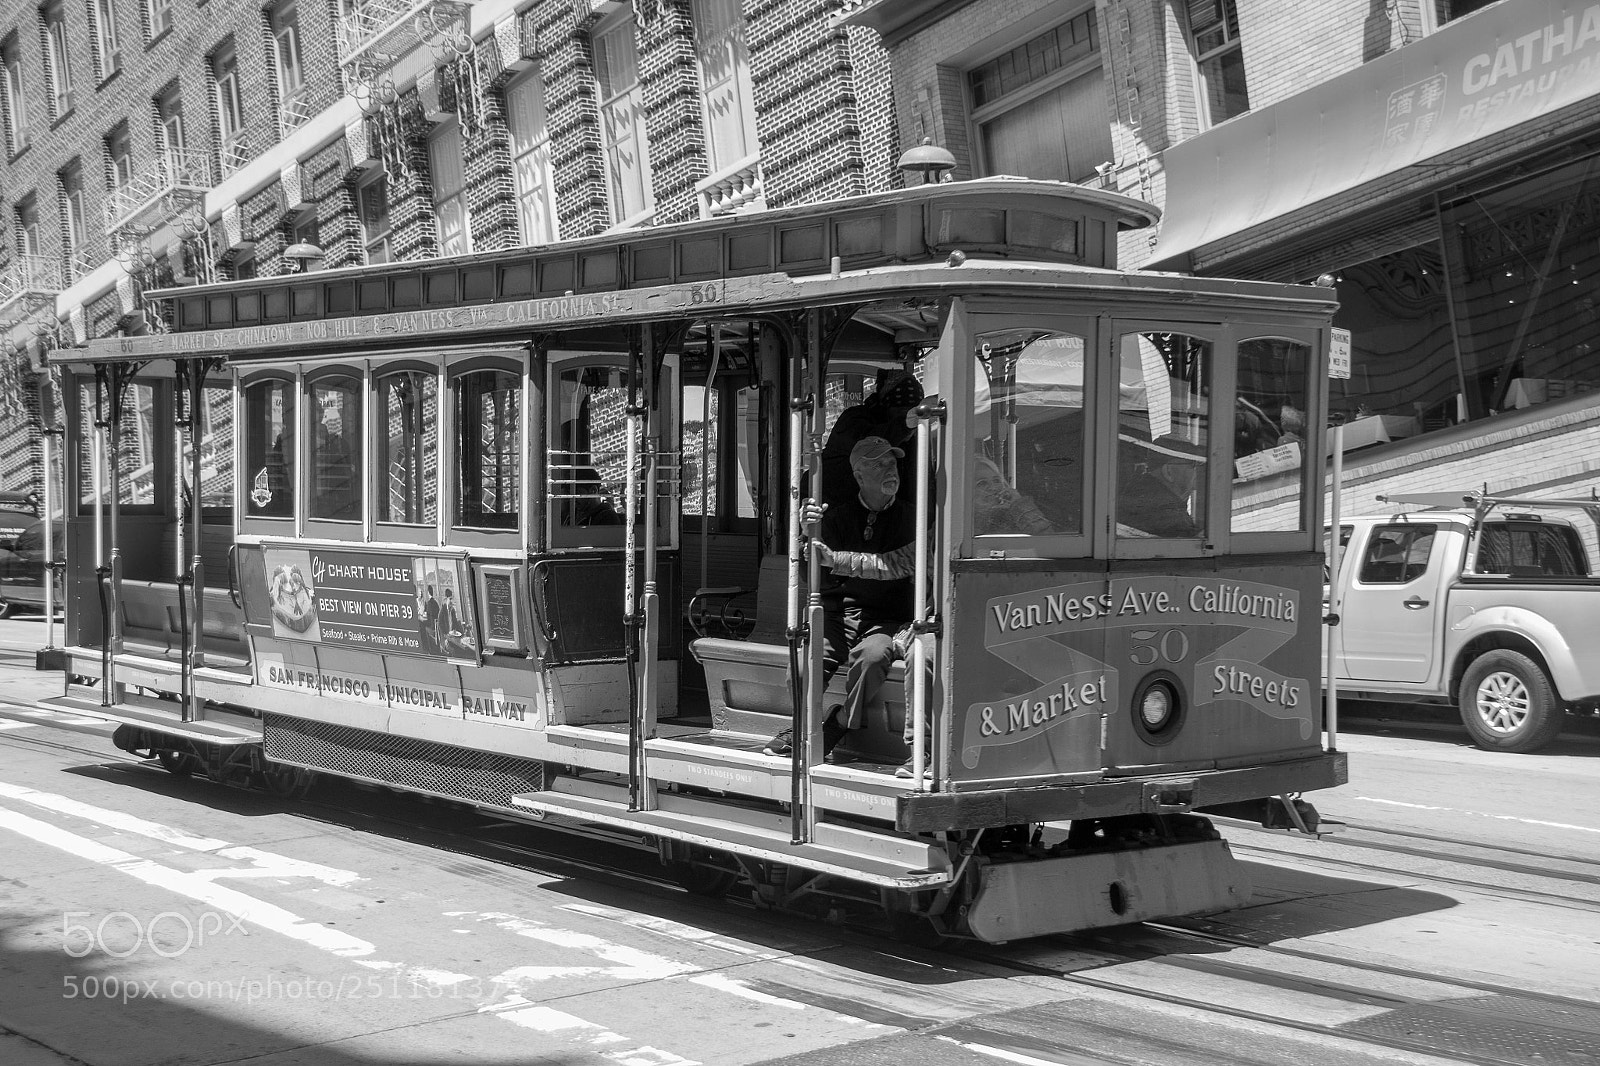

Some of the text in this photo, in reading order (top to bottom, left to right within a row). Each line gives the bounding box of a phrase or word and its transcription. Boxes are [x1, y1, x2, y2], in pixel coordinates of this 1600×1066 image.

[1463, 4, 1600, 95] CATHA
[171, 333, 207, 350] MARKET
[238, 326, 293, 345] CHINATOWN
[305, 322, 328, 340] NOB
[335, 319, 360, 338] HILL
[395, 314, 418, 332] VAN
[421, 311, 453, 330] NESS
[506, 297, 596, 323] CALIFORNIA
[691, 283, 717, 305] 50
[328, 564, 364, 579] CHART
[368, 566, 410, 582] HOUSE
[319, 598, 413, 620] BEST VIEW ON PIER 39
[993, 601, 1041, 634] Van
[1045, 592, 1113, 625] Ness
[1188, 584, 1296, 622] California
[322, 628, 420, 648] Seafood Steaks Prime Rib & More
[1130, 628, 1190, 666] 50
[269, 666, 294, 686] SAN
[297, 670, 371, 699] FRANCISCO
[463, 695, 528, 722] RAILWAY
[981, 674, 1108, 737] & Market
[1213, 664, 1300, 707] Streets
[687, 764, 702, 774] TWO
[825, 788, 841, 798] TWO
